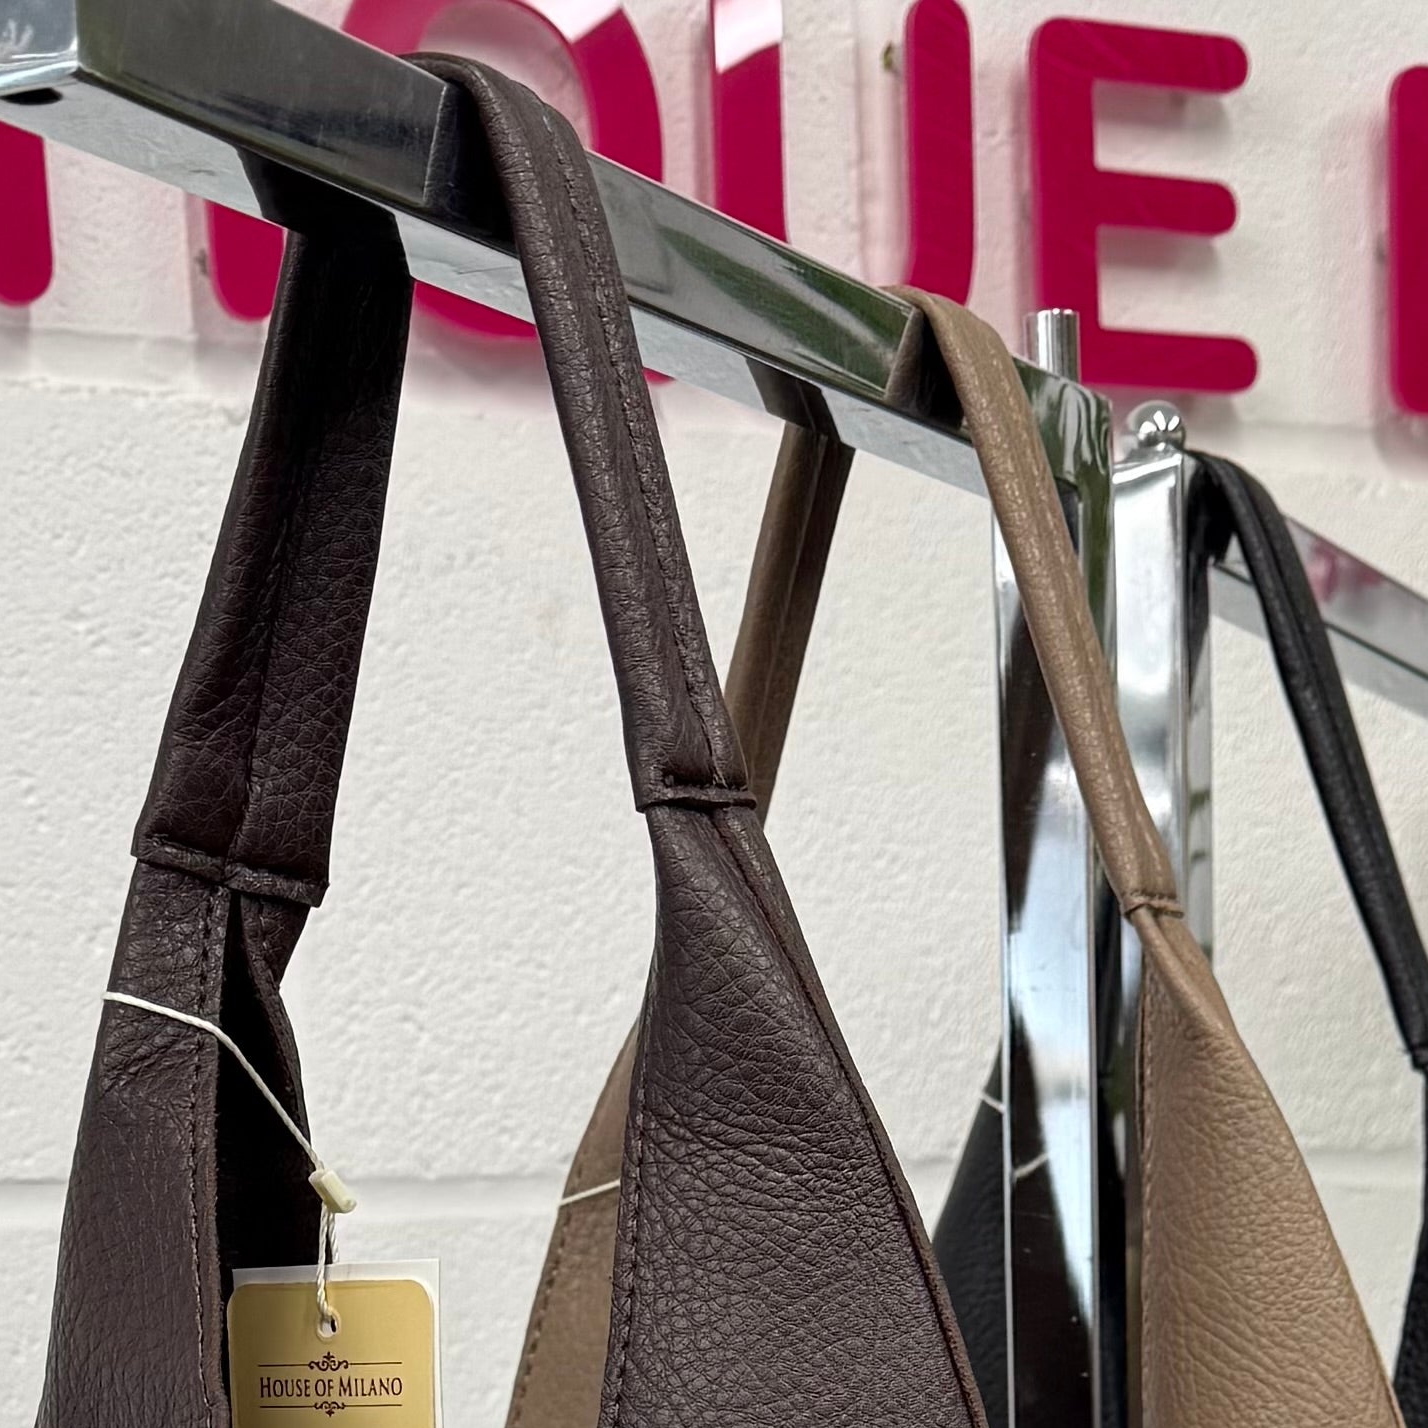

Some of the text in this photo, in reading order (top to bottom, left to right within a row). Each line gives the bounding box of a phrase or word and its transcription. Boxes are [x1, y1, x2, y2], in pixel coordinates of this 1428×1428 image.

[259, 1375, 403, 1398] HOUSE OF MILANO
